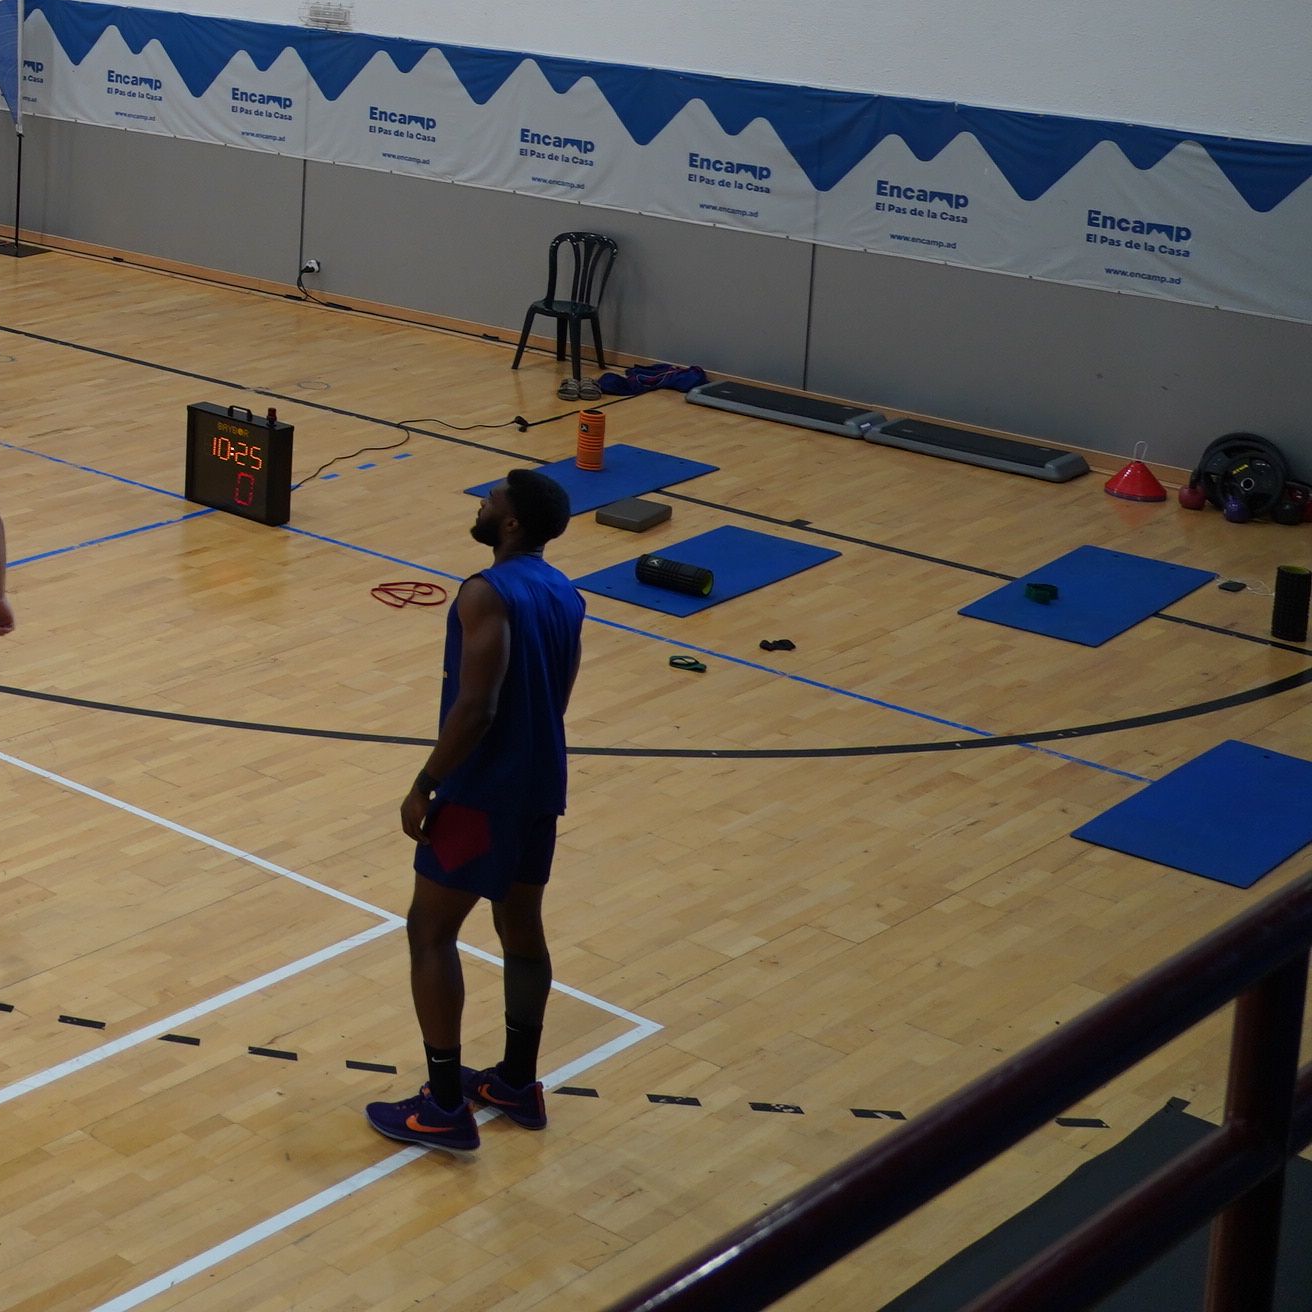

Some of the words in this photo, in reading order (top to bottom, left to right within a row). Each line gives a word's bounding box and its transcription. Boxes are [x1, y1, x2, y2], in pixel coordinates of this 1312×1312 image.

[28, 75, 43, 83] Casa
[107, 70, 162, 90] Encamp
[128, 90, 136, 98] de
[138, 91, 144, 99] la
[146, 92, 162, 101] Casa
[232, 88, 292, 109] Encamp
[240, 107, 252, 115] Pas
[265, 110, 272, 118] la
[274, 111, 292, 120] Casa
[370, 107, 436, 130] Encamp
[378, 127, 392, 135] Pas
[394, 129, 404, 137] de
[416, 132, 435, 142] Casa
[521, 128, 594, 154] Encamp
[520, 148, 527, 156] El
[530, 150, 545, 159] Pas
[548, 152, 559, 161] de
[572, 156, 593, 166] Casa
[689, 153, 771, 180] Encamp
[532, 176, 584, 189] www.encamp.ad
[688, 174, 696, 182] El
[699, 175, 714, 185] Pas
[718, 179, 731, 187] de
[735, 181, 743, 189] la
[746, 183, 770, 193] Casa
[877, 179, 969, 209] Encamp
[699, 204, 758, 217] www.encamp.ad
[876, 202, 885, 211] El
[888, 204, 907, 214] Pas
[910, 207, 924, 217] de
[927, 210, 937, 218] la
[940, 212, 967, 223] Casa
[1087, 209, 1191, 242] Encamp
[890, 234, 956, 249] www.encamp.ad
[1086, 234, 1096, 243] El
[1100, 236, 1121, 246] Pas
[1125, 240, 1141, 249] de
[1144, 243, 1155, 252] la
[1159, 245, 1190, 257] Casa
[1105, 267, 1181, 284] www.encamp.ad
[212, 437, 263, 470] 10:25
